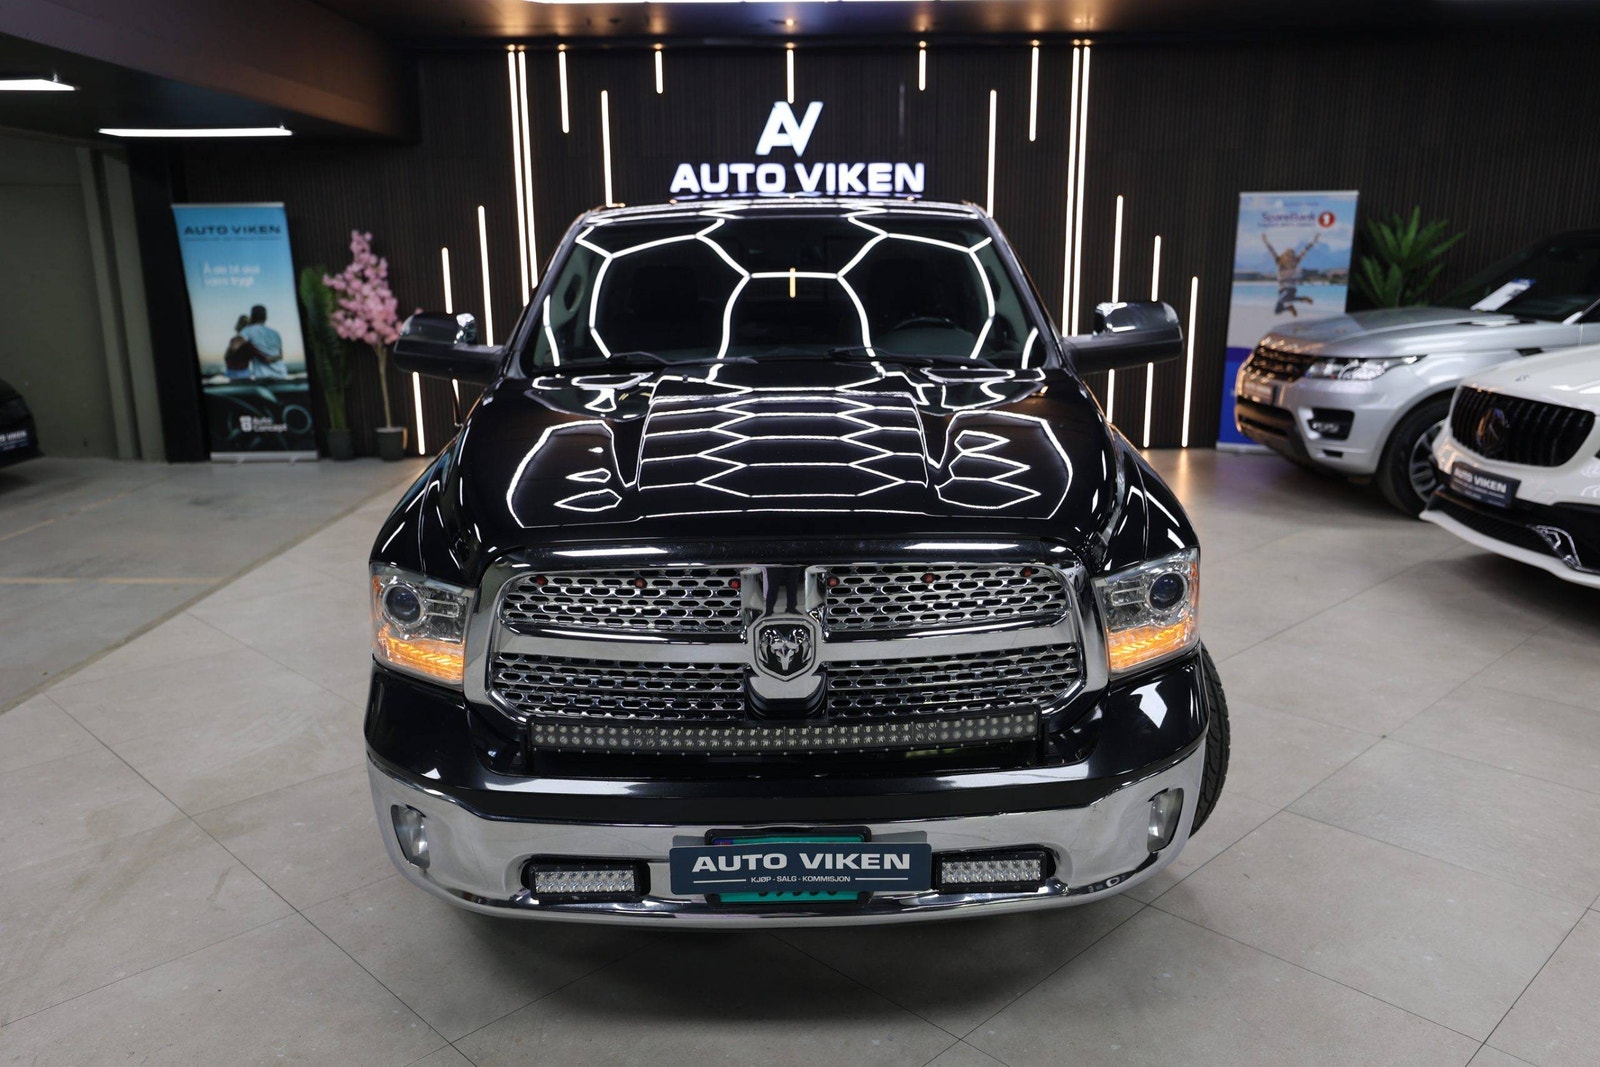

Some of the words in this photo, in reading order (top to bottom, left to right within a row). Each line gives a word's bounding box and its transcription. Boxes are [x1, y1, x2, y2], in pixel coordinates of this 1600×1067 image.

[755, 101, 824, 156] AV
[669, 162, 787, 193] AUTO
[793, 162, 925, 193] VIKEN
[184, 225, 228, 235] AUTO
[232, 224, 282, 235] VIKEN
[1473, 475, 1507, 493] VIKEN
[691, 852, 788, 873] AUTO
[799, 853, 910, 870] VIKEN
[750, 876, 772, 884] KJØP
[776, 875, 798, 883] SALG
[802, 875, 851, 883] KOMMISJON
